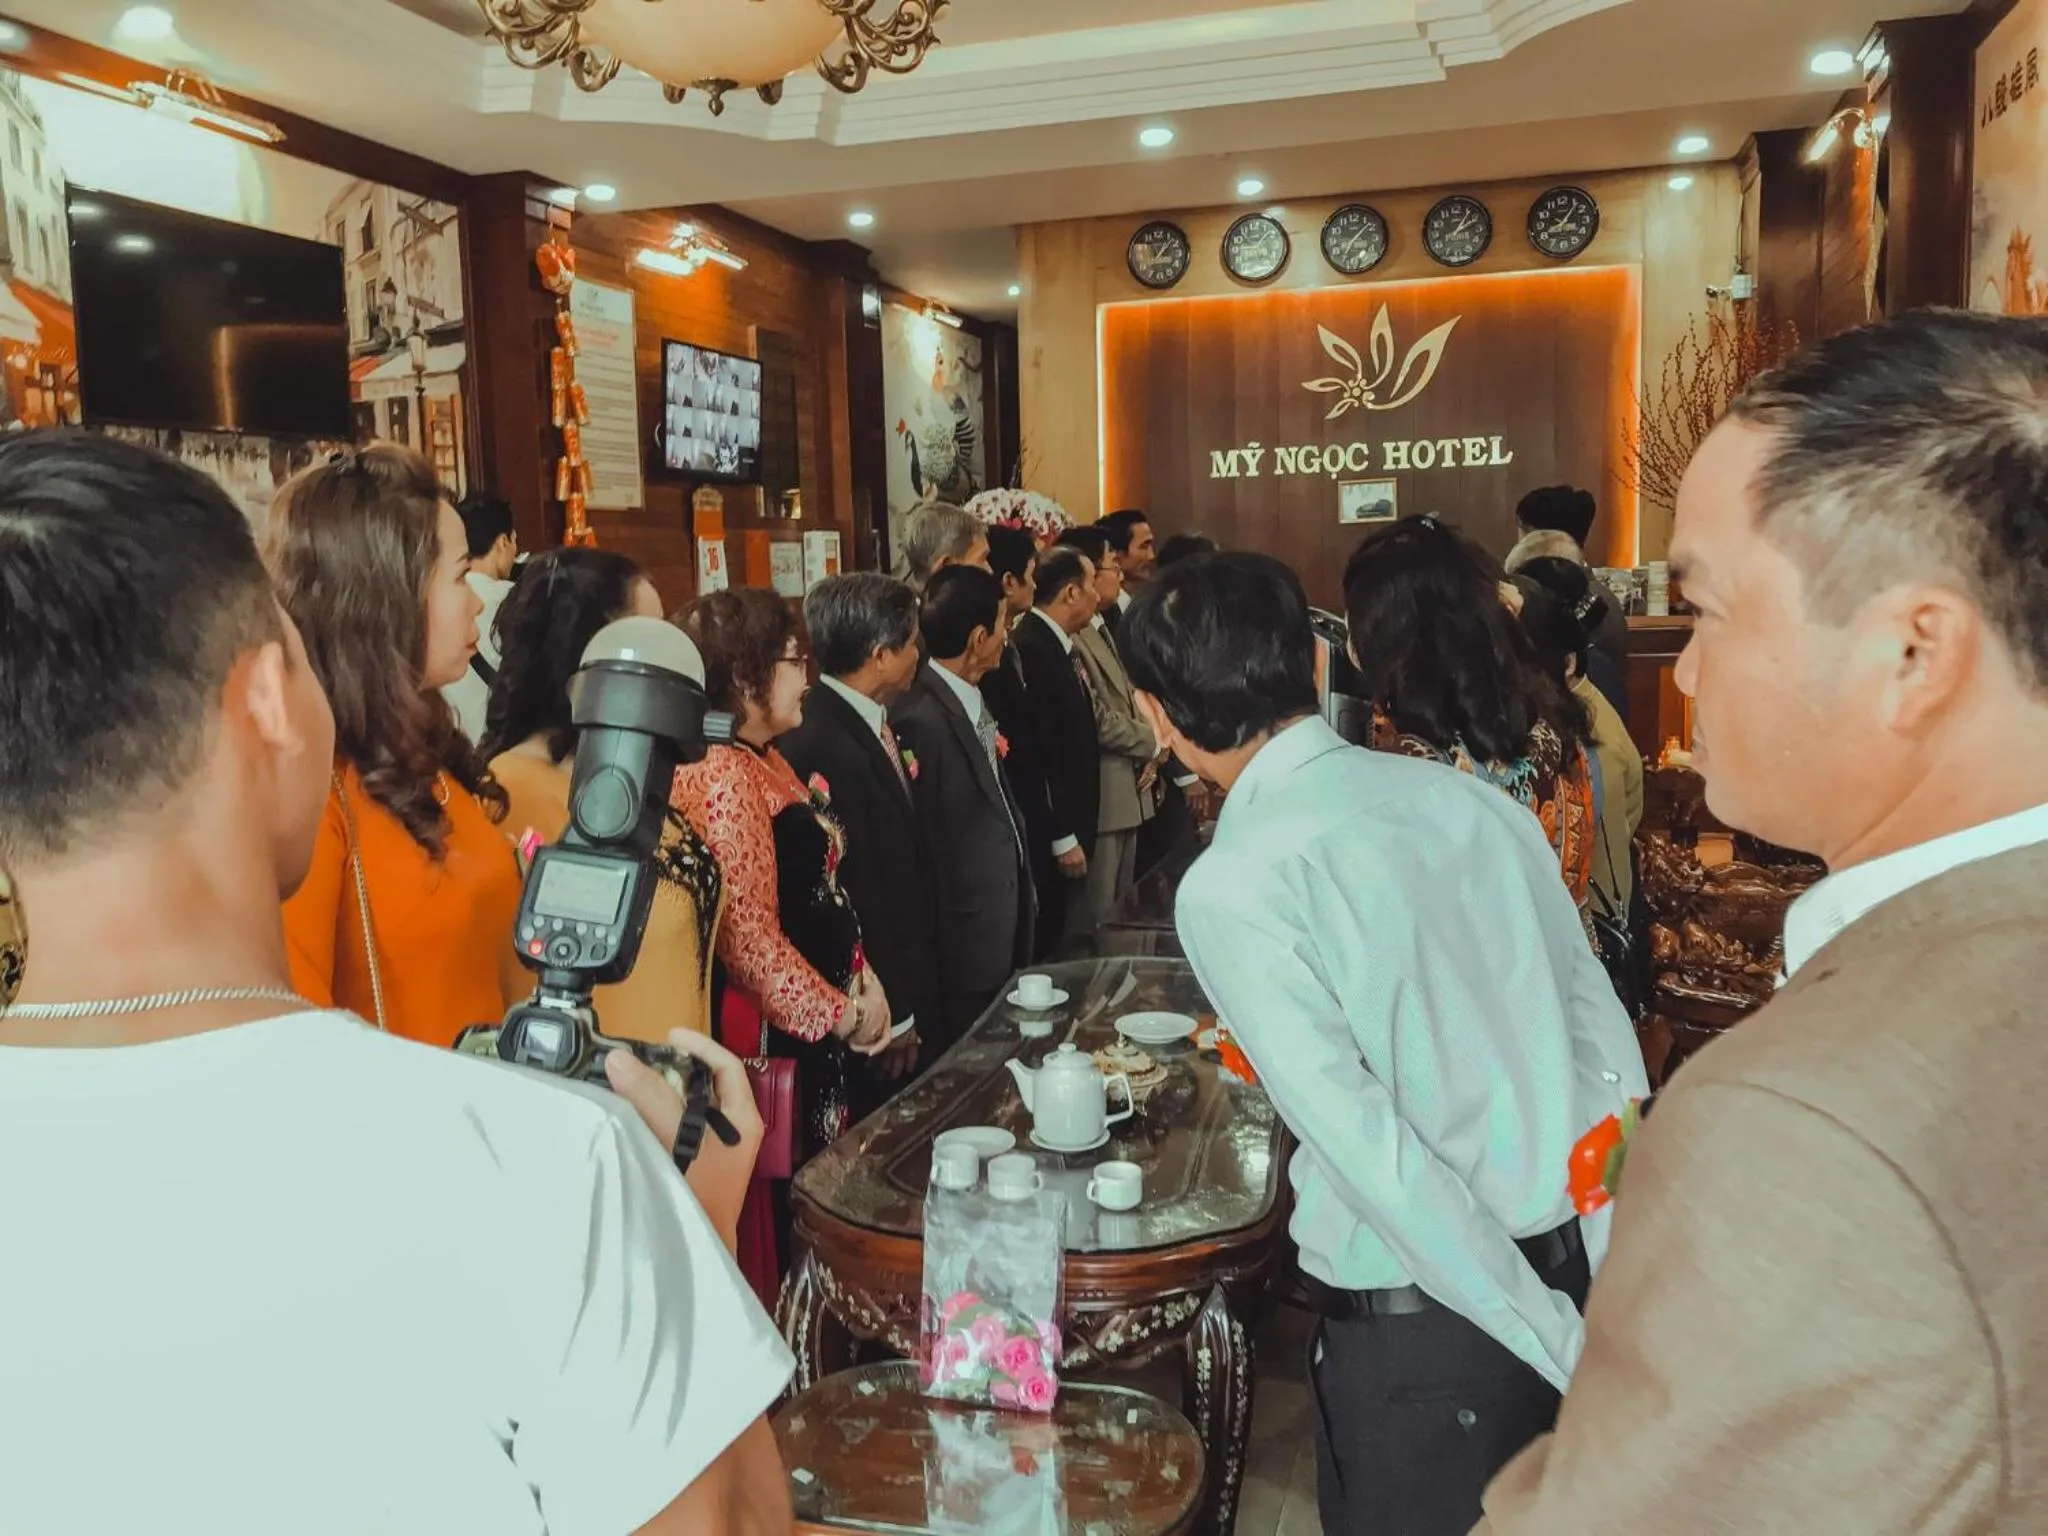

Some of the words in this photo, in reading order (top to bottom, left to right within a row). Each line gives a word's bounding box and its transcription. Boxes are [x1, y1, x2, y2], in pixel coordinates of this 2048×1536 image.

[1209, 441, 1265, 478] MỸ
[1274, 442, 1369, 479] NGỌC
[1382, 436, 1514, 471] HOTEL
